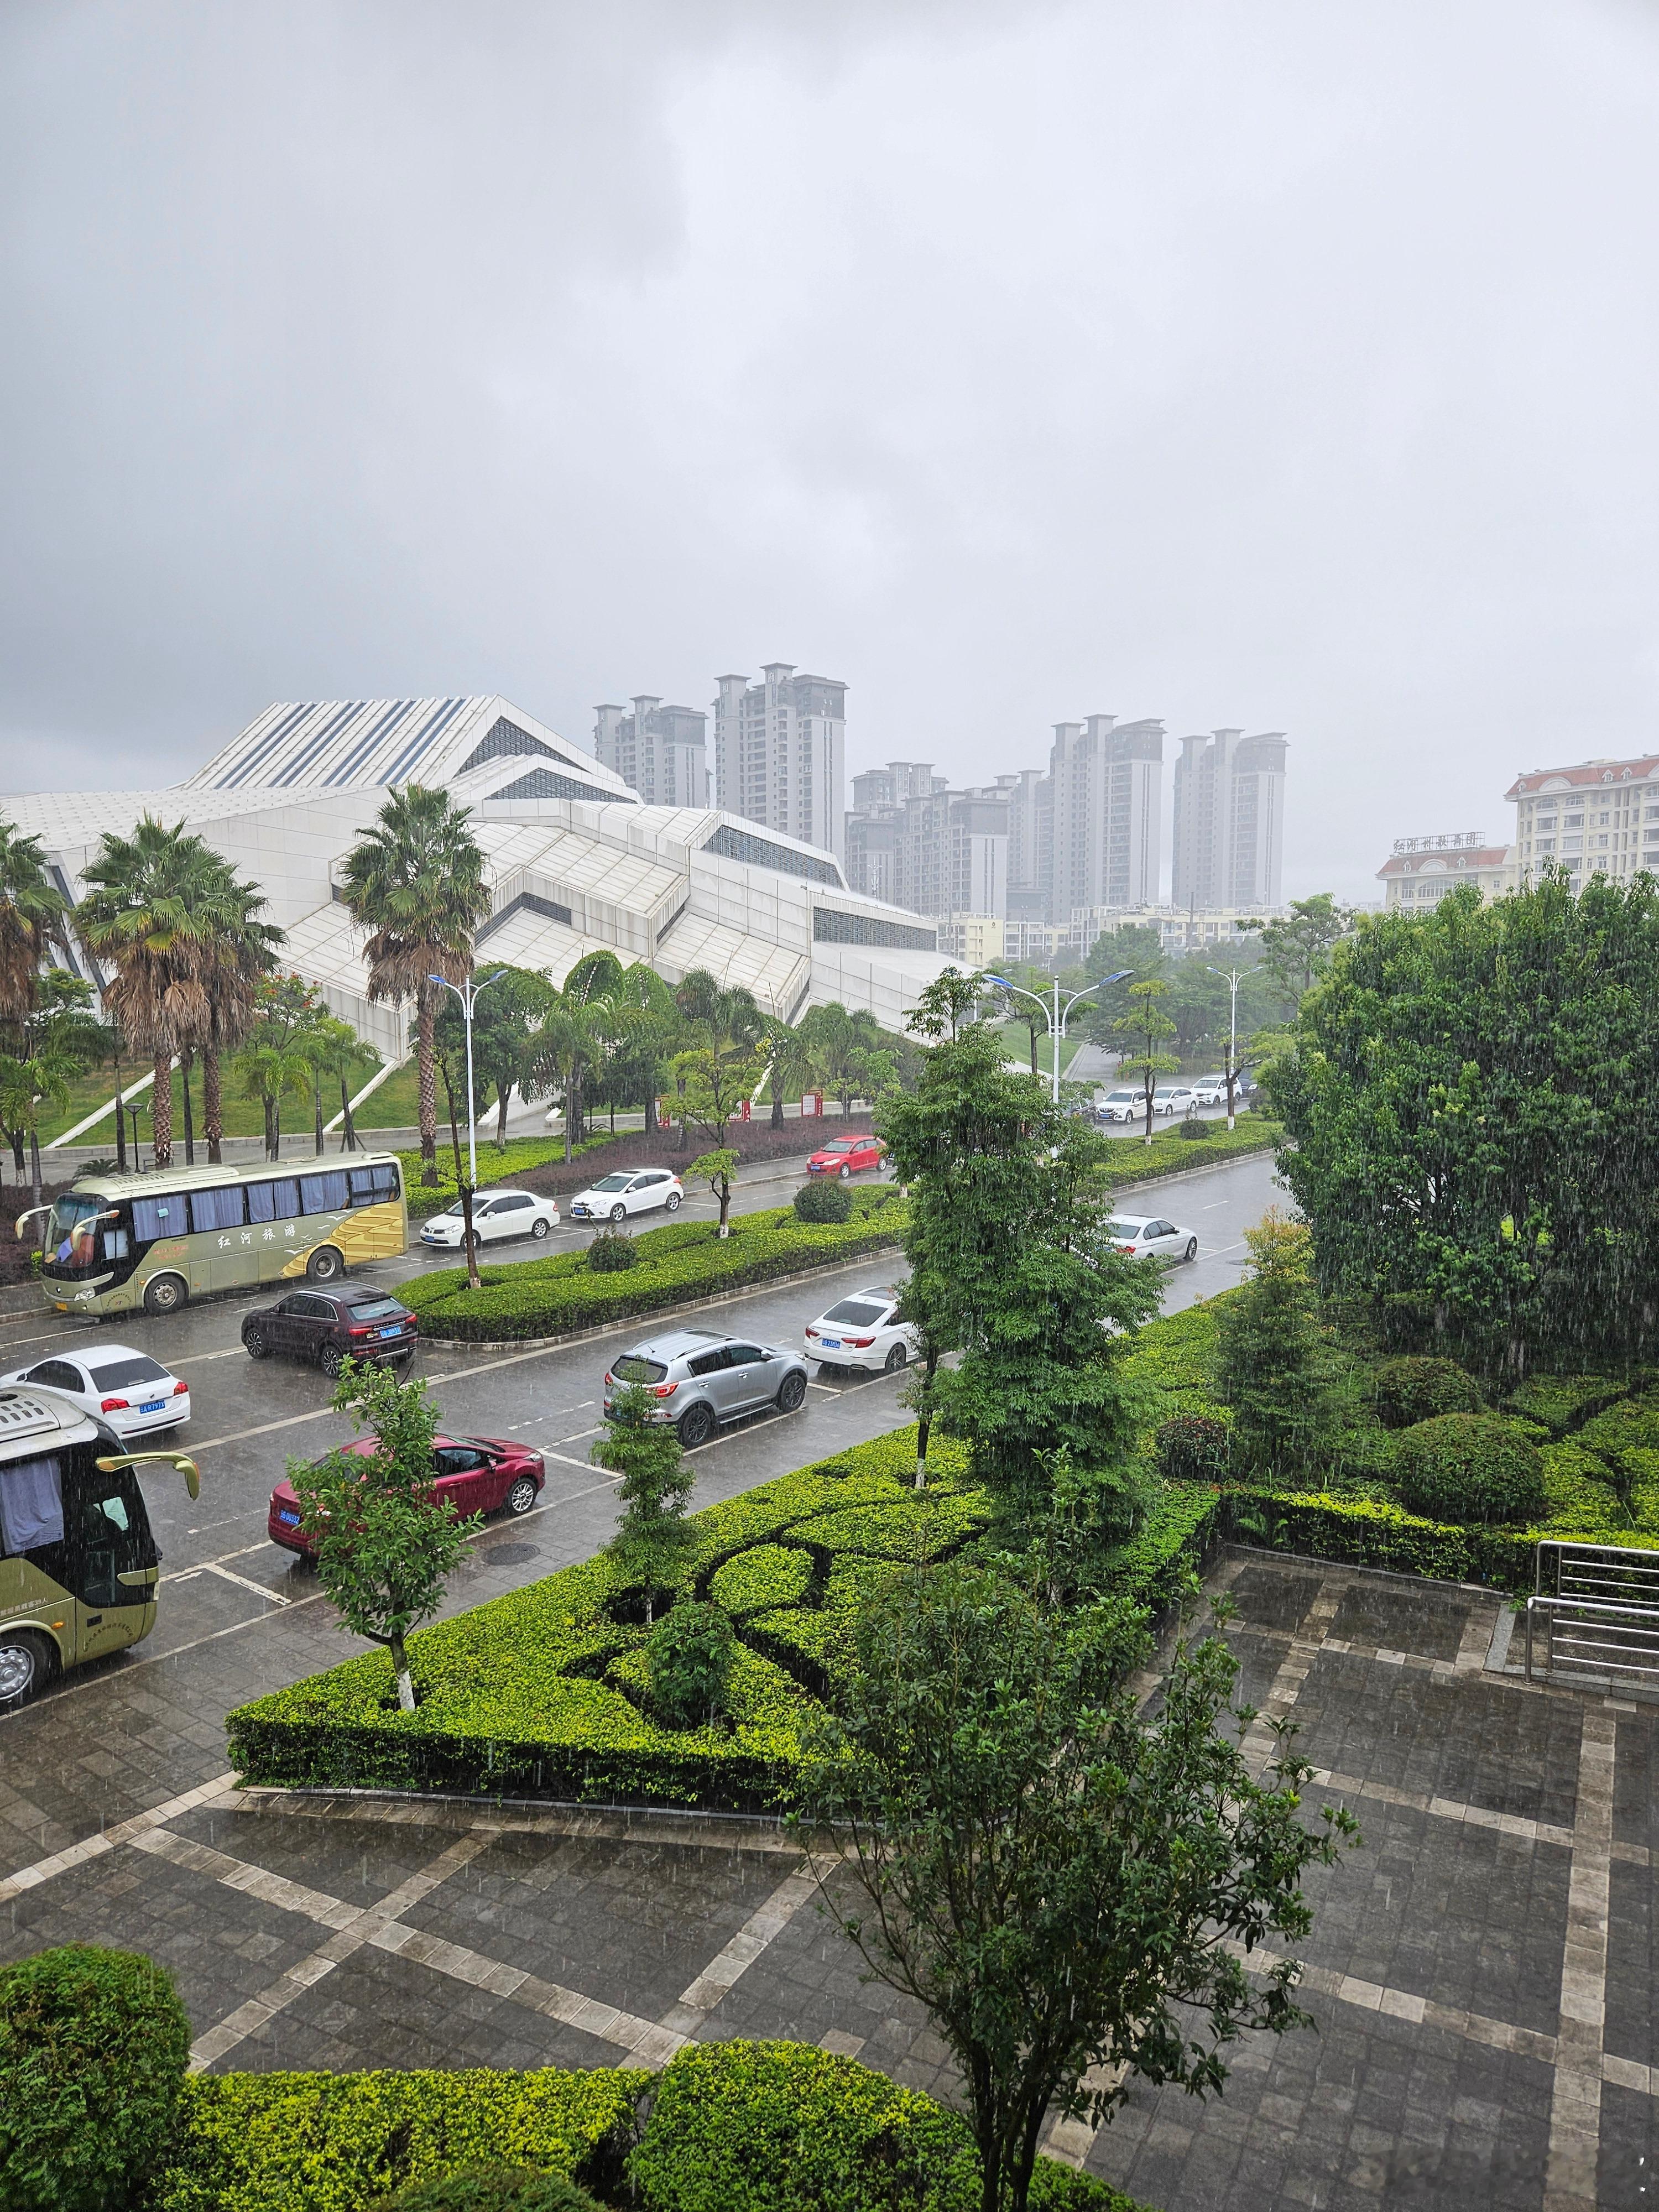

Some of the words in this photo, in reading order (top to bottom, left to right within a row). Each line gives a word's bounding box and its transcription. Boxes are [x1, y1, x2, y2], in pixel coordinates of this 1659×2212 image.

[1393, 832, 1477, 853] 红河州歌舞团
[217, 1223, 296, 1249] 红河旅游
